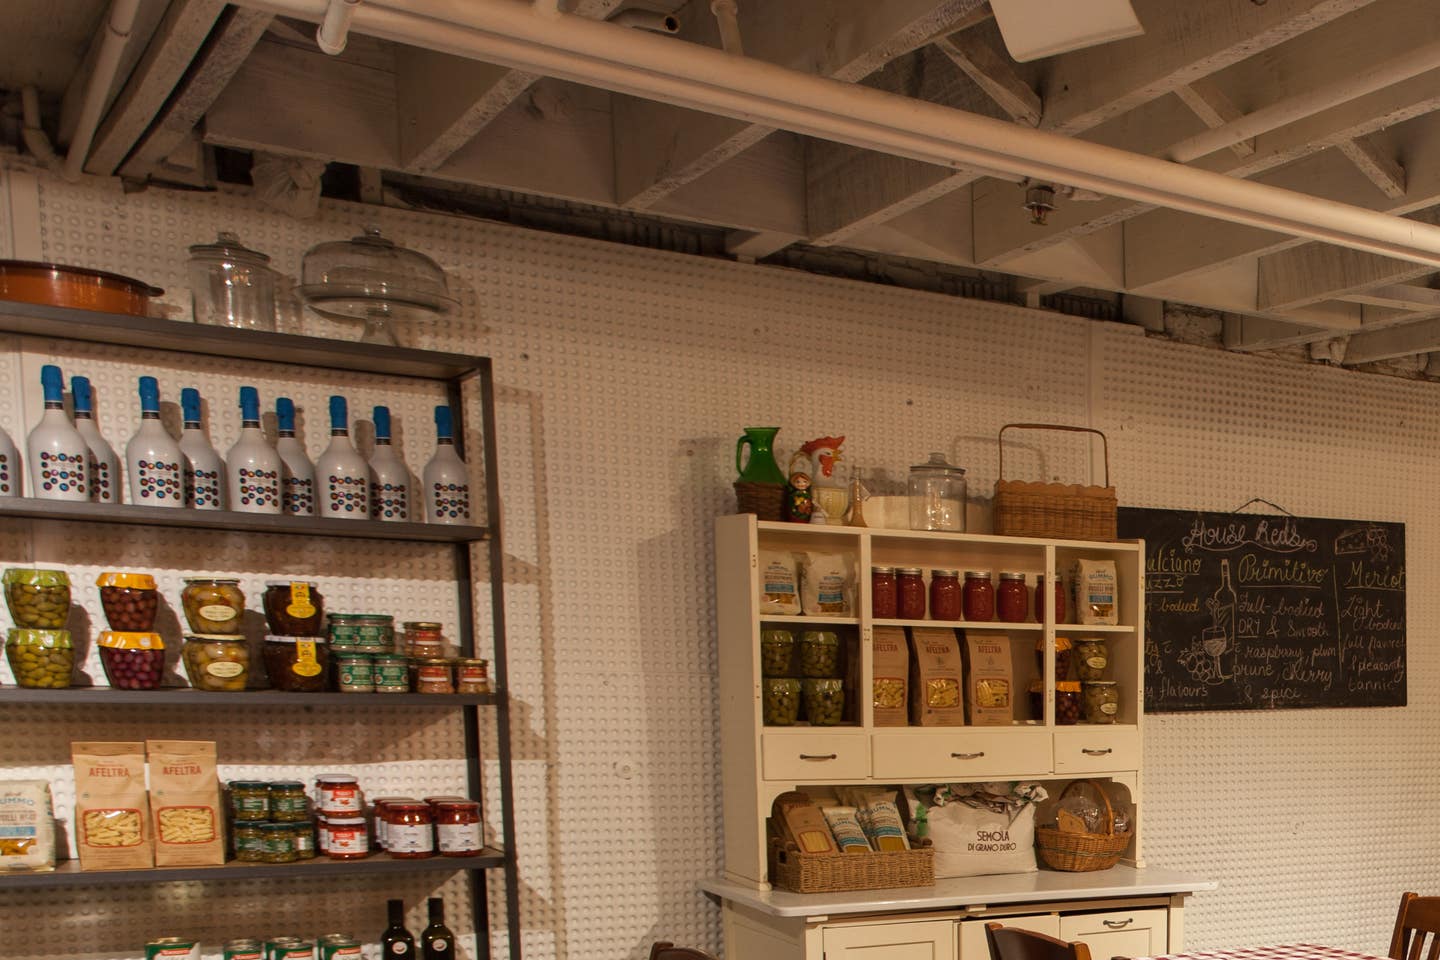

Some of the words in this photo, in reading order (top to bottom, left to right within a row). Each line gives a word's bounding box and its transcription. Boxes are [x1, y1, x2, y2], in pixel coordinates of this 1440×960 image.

[1190, 520, 1246, 546] House
[1255, 518, 1302, 547] Reds
[1239, 553, 1329, 583] Primitivo
[88, 767, 130, 778] AFELTRA
[162, 765, 203, 776] AFELTRA
[976, 830, 1010, 842] SEMOLA
[967, 843, 975, 852] DI
[975, 843, 999, 852] GRANO
[1000, 842, 1017, 852] DURO
